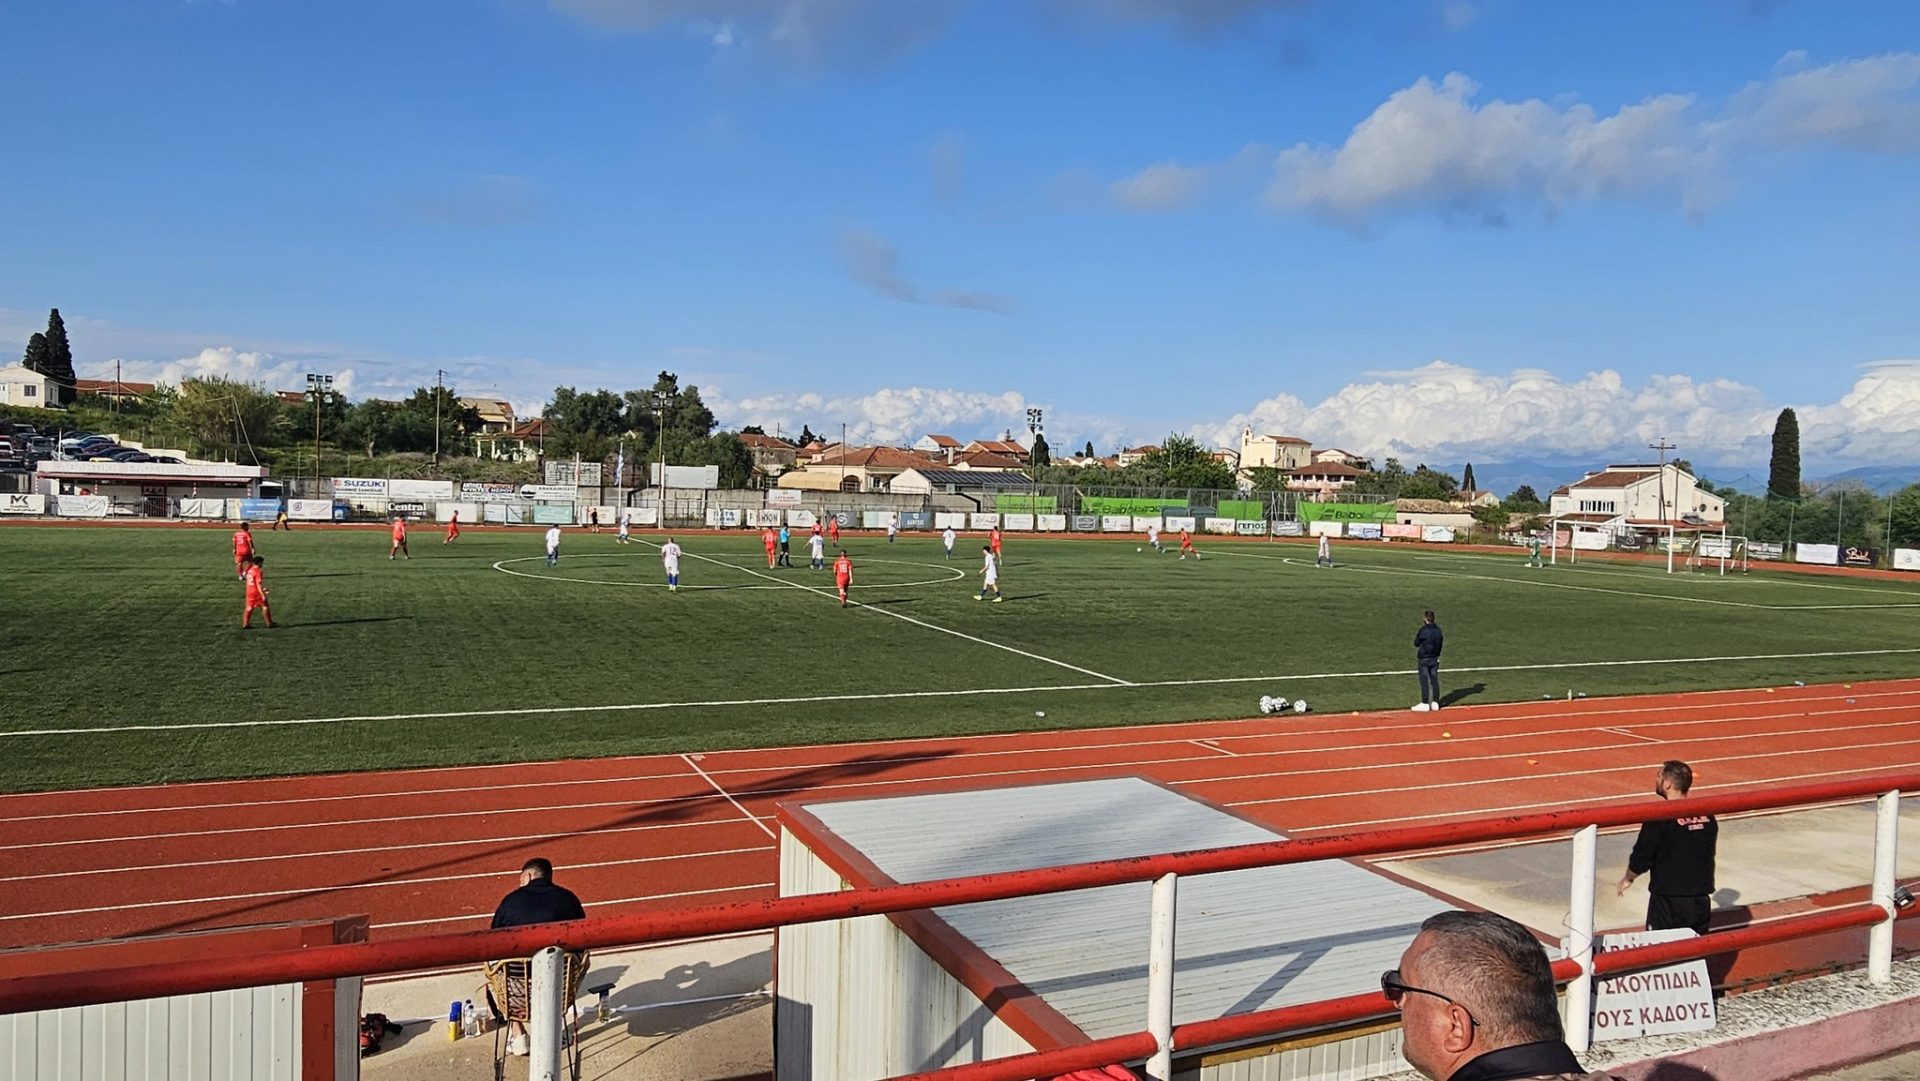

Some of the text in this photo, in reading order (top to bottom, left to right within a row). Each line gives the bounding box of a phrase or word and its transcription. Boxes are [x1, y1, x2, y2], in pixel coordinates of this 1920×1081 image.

[343, 479, 386, 488] SUZUKI
[388, 502, 427, 511] Central
[1605, 970, 1702, 995] ΣΚΟΥΠΙΔΙΑ
[1639, 1001, 1711, 1025] ΚΑΔΟΥΣ
